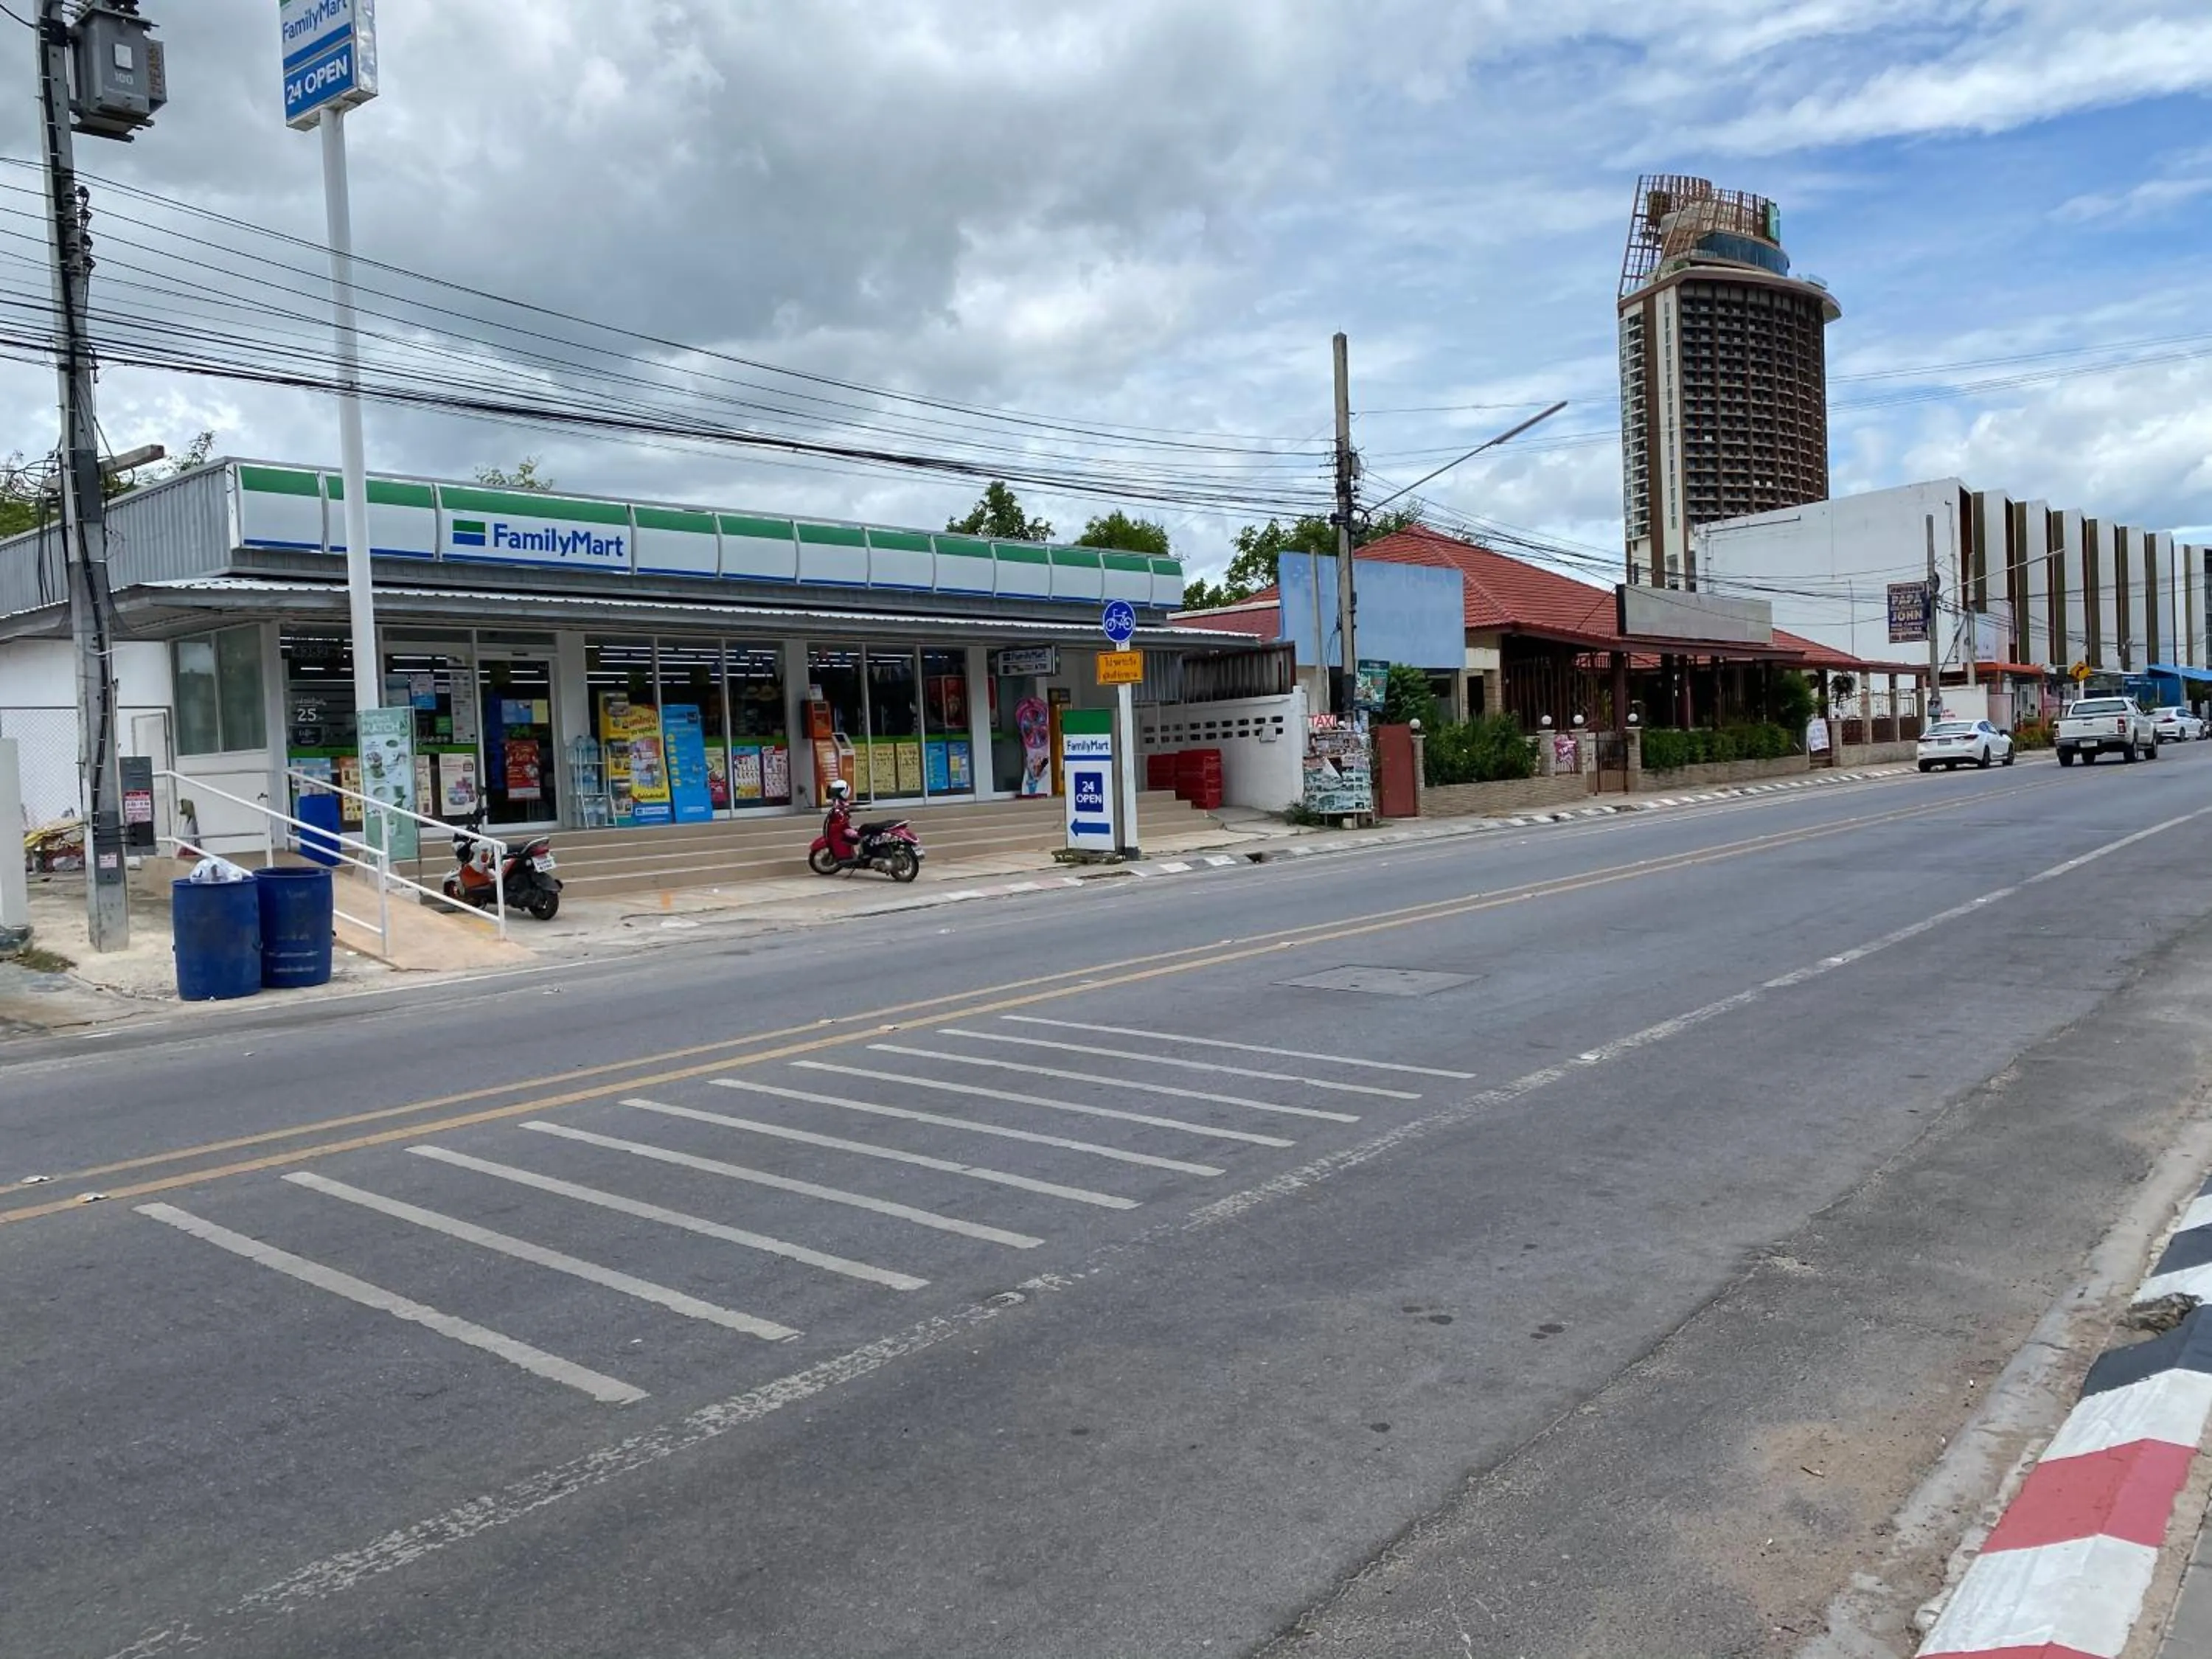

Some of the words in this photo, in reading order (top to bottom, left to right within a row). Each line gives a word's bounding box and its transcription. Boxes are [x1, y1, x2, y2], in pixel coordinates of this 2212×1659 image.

[283, 0, 347, 43] FamilyMart
[287, 80, 302, 105] 24
[305, 55, 348, 94] OPEN
[493, 523, 624, 557] FamilyMart
[1892, 610, 1924, 622] JOHN
[296, 708, 317, 722] 25
[1309, 714, 1335, 728] TAXI
[1067, 740, 1109, 753] FamilyMart
[1082, 781, 1095, 793] 24
[1076, 793, 1102, 804] OPEN
